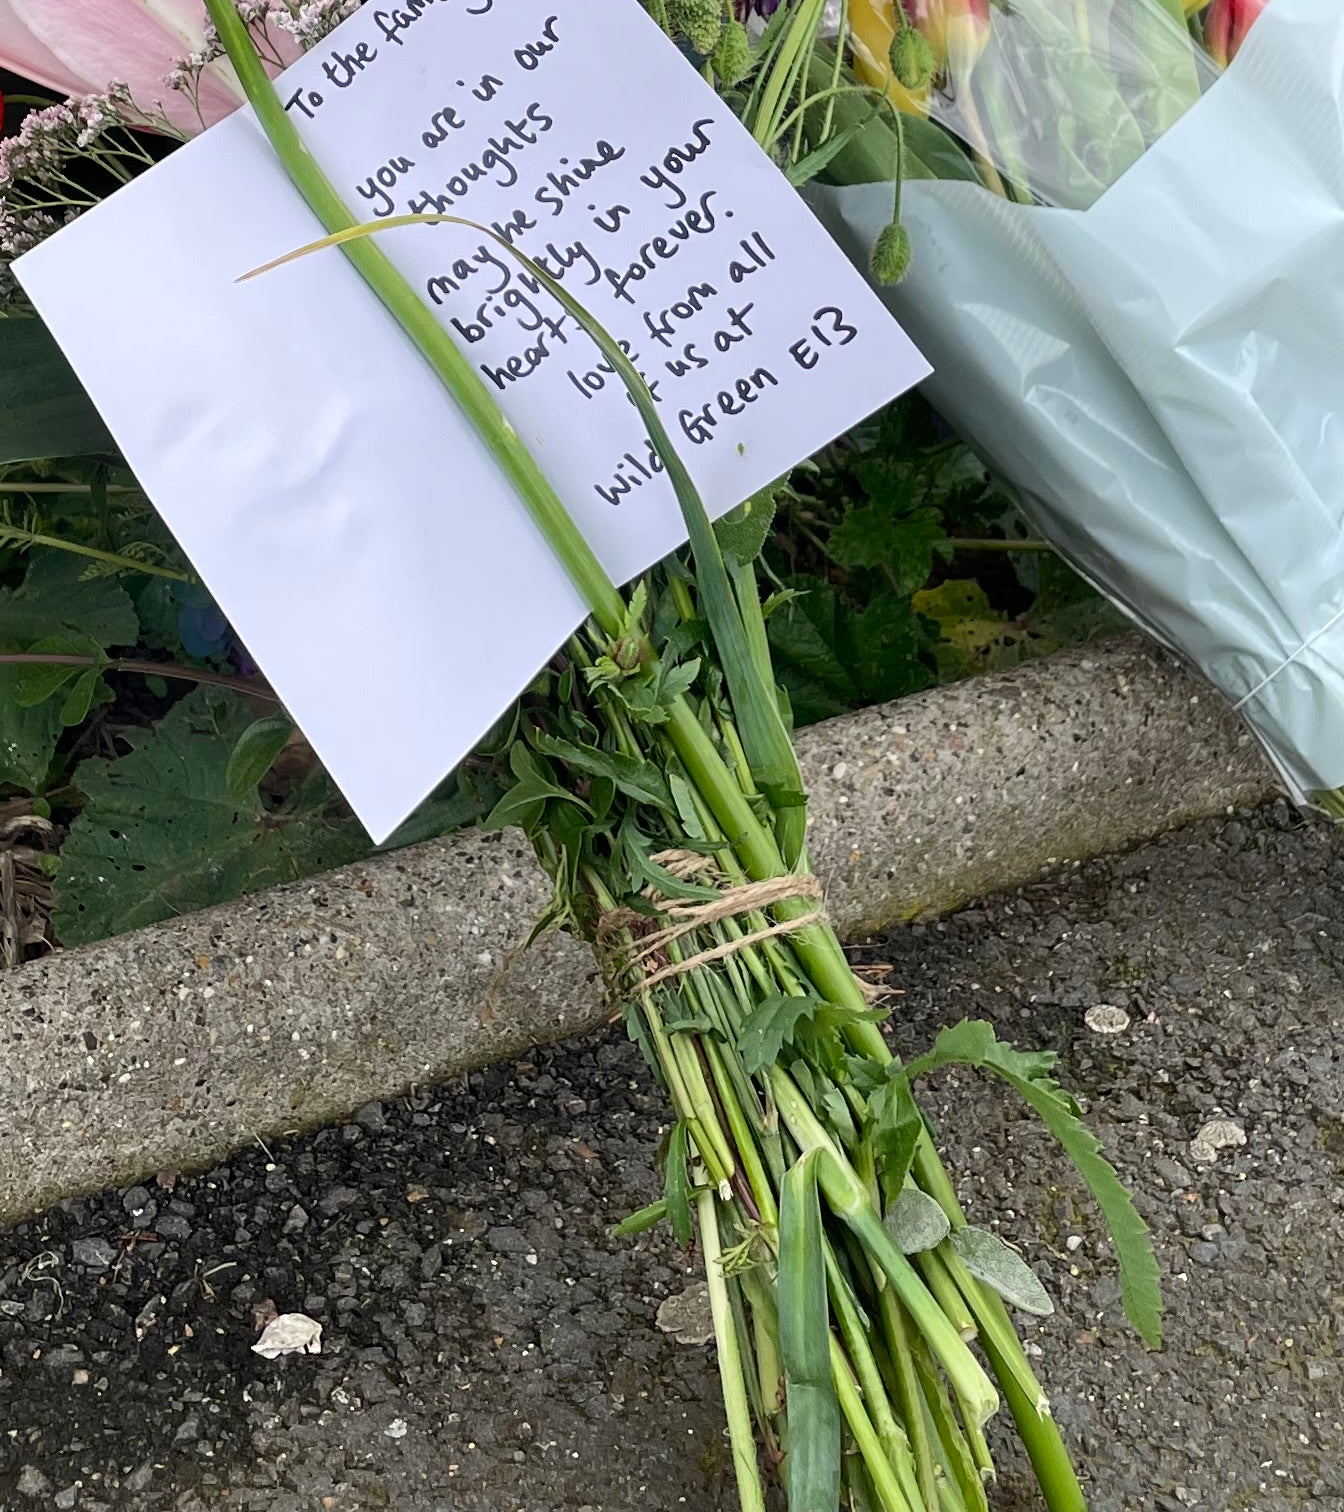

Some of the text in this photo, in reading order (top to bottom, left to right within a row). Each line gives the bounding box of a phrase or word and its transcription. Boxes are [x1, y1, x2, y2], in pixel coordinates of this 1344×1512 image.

[285, 87, 324, 119] To
[322, 42, 378, 88] the
[355, 15, 560, 217] you are in our
[407, 102, 553, 225] thoughts
[426, 139, 626, 305] may he shine
[450, 118, 715, 344] brightly in your
[566, 230, 776, 400] love from all
[604, 190, 734, 304] forever.
[664, 343, 709, 377] us
[713, 302, 755, 353] at
[678, 366, 779, 445] Green
[788, 305, 858, 370] E13
